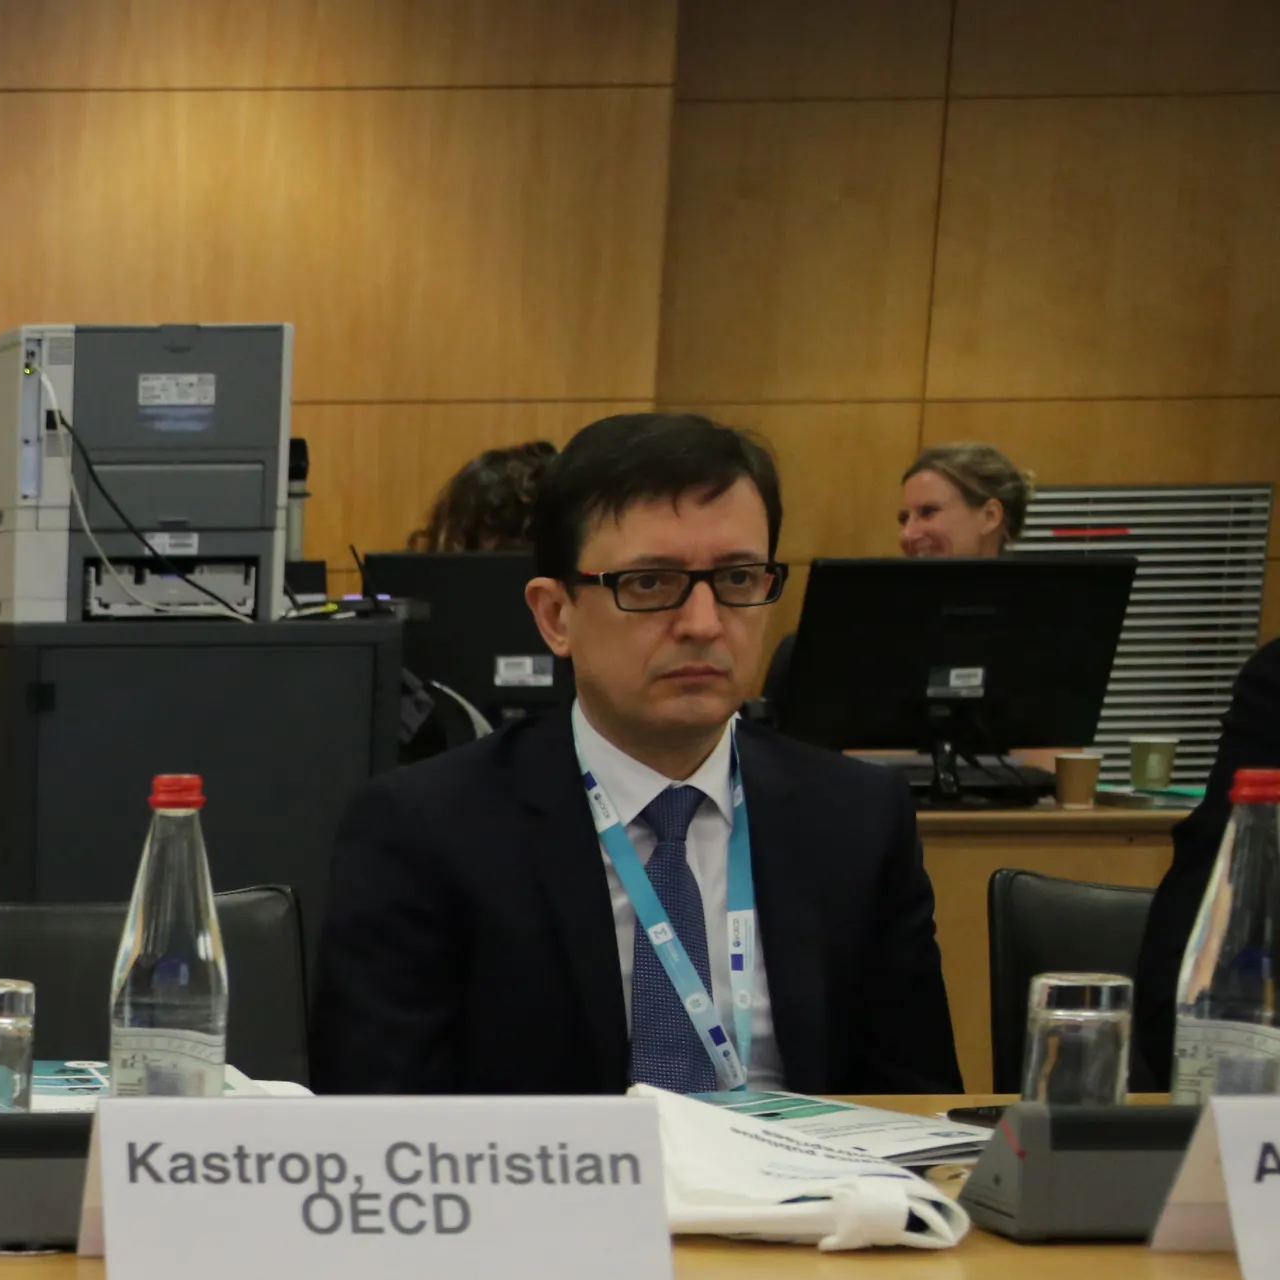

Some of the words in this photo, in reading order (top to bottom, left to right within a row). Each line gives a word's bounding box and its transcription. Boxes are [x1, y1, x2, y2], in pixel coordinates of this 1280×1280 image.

[127, 1141, 364, 1195] Kastrop,
[384, 1141, 641, 1186] Christian
[301, 1191, 471, 1236] OECD
